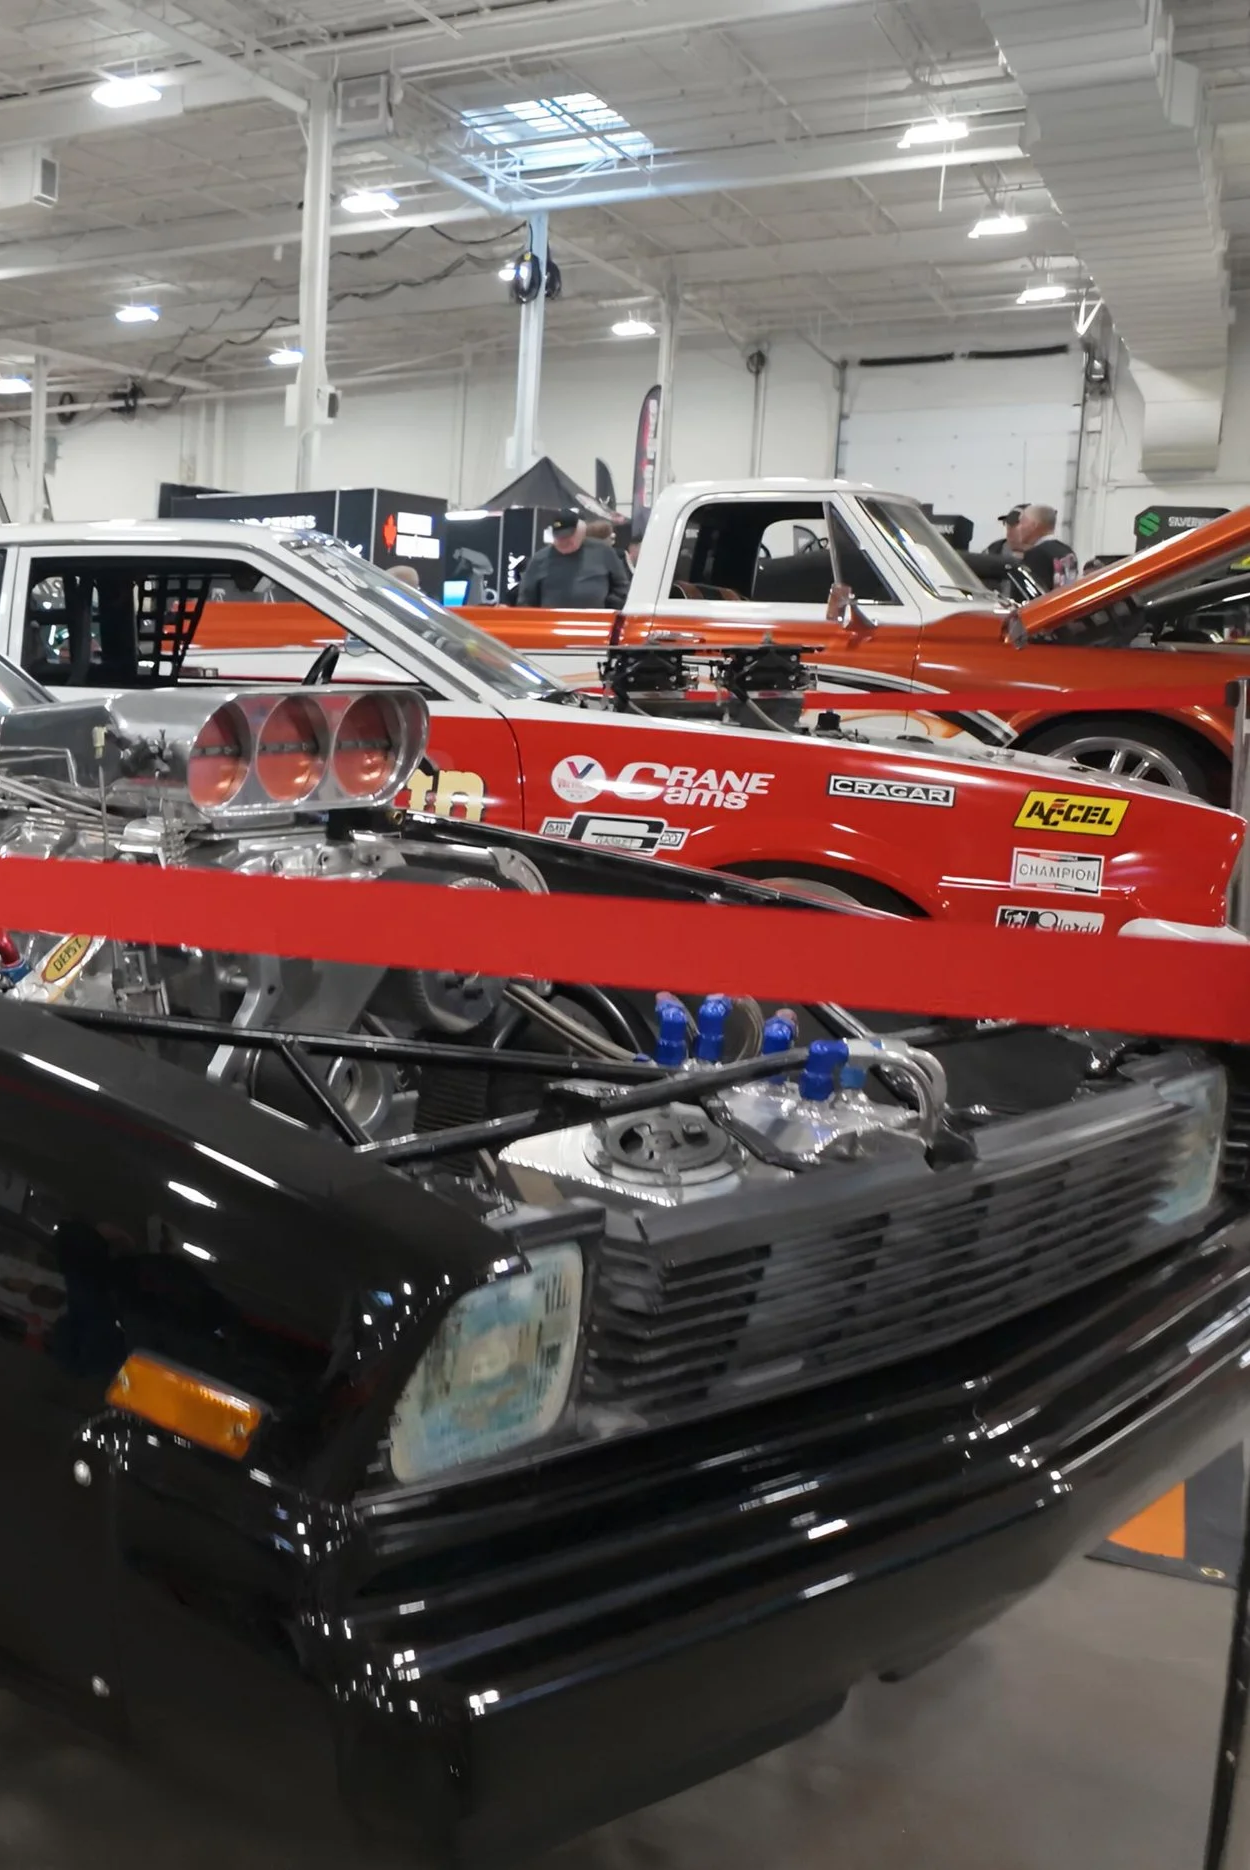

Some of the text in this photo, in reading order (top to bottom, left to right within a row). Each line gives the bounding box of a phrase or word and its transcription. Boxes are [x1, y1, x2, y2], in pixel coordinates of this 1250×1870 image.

[613, 762, 775, 801] CRANE
[835, 780, 947, 802] CRAGAR
[1026, 799, 1114, 826] ACCEL
[1019, 863, 1096, 882] CHAMPION
